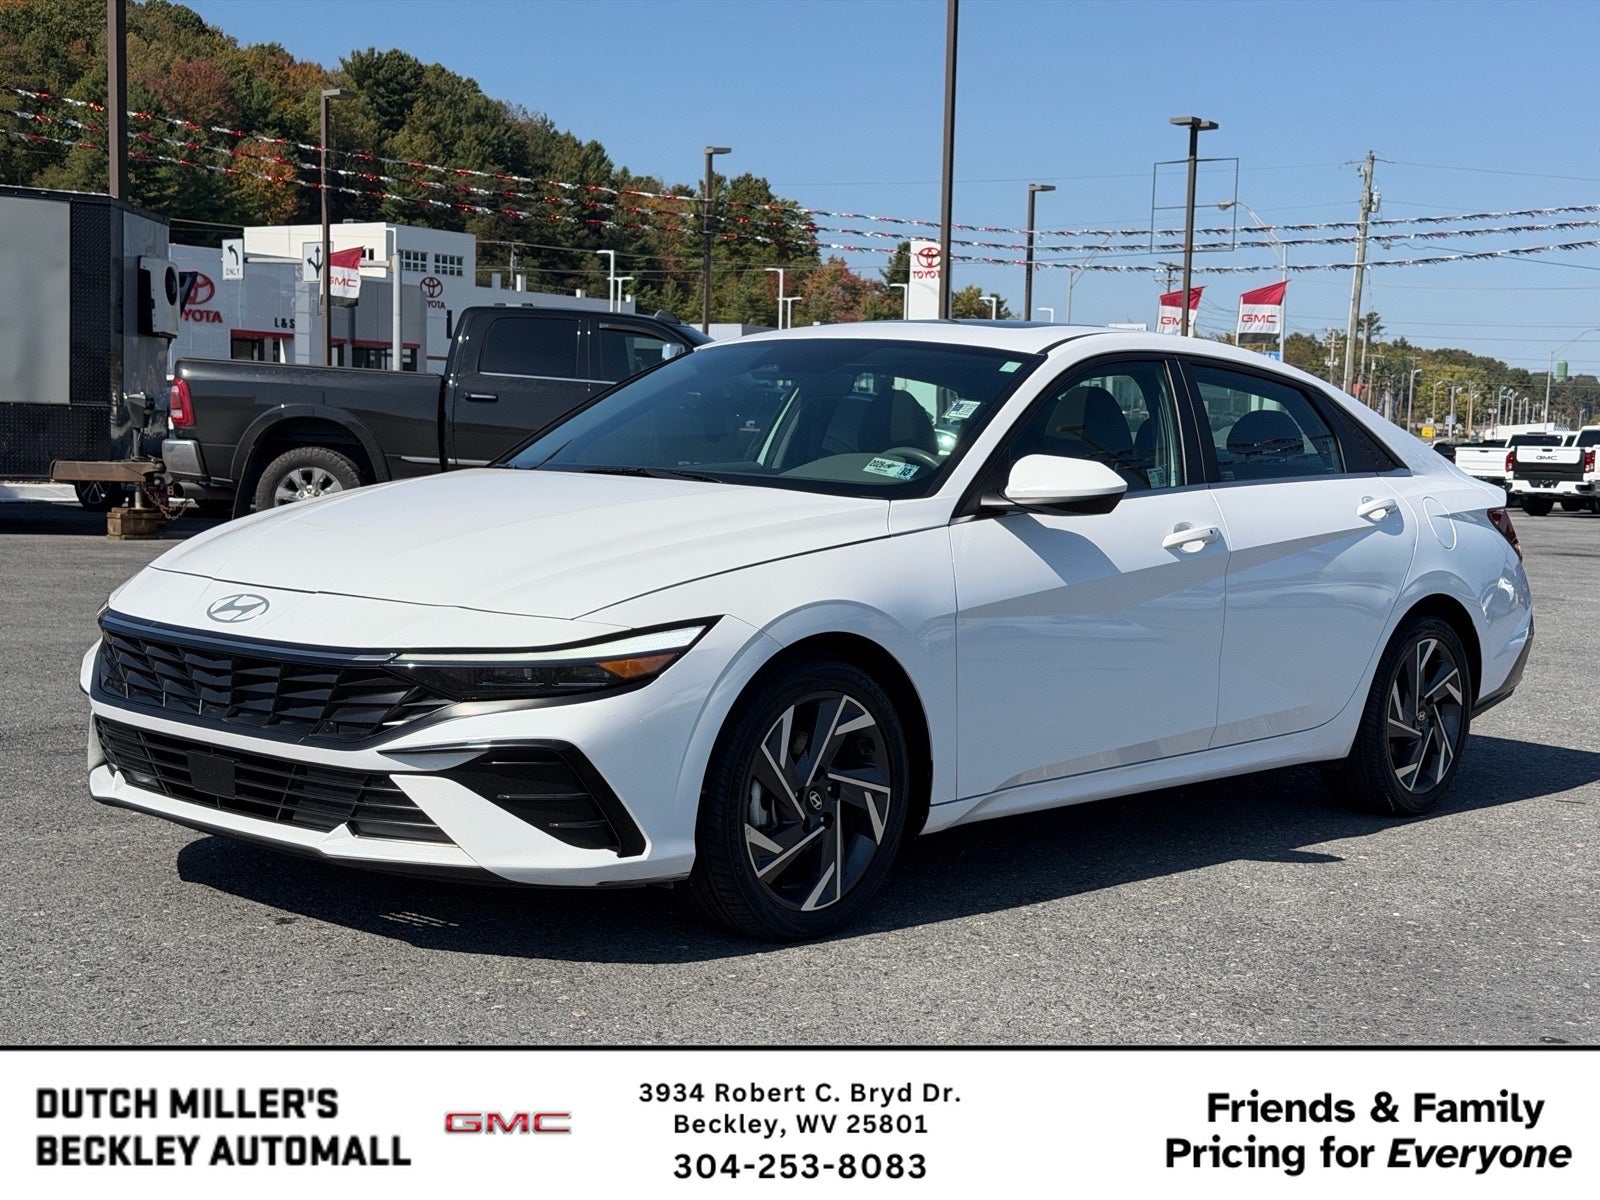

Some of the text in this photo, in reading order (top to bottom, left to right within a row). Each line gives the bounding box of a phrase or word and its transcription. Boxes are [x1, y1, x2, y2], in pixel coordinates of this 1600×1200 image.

[912, 270, 941, 279] TOYOT
[427, 300, 446, 310] YOTA
[182, 309, 223, 323] YOTA
[1241, 314, 1277, 324] GMC
